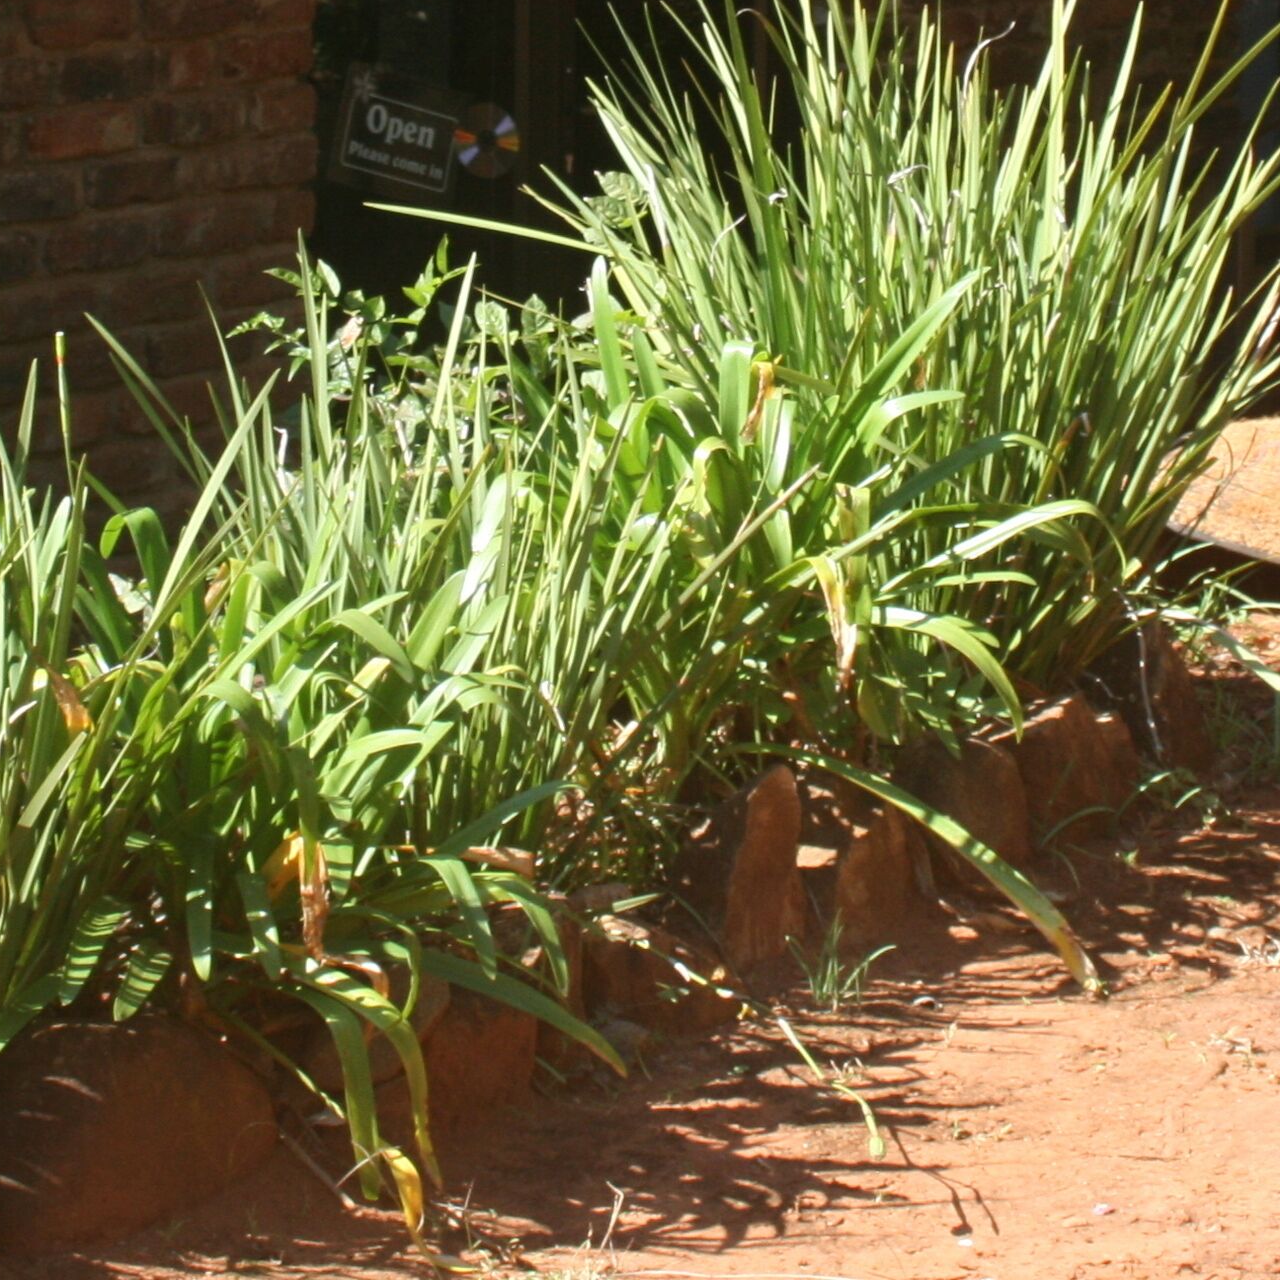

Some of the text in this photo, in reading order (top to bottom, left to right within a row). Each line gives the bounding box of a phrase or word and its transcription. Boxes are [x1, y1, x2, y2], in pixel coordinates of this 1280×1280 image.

[366, 104, 435, 149] Open
[348, 140, 443, 180] Please come in
